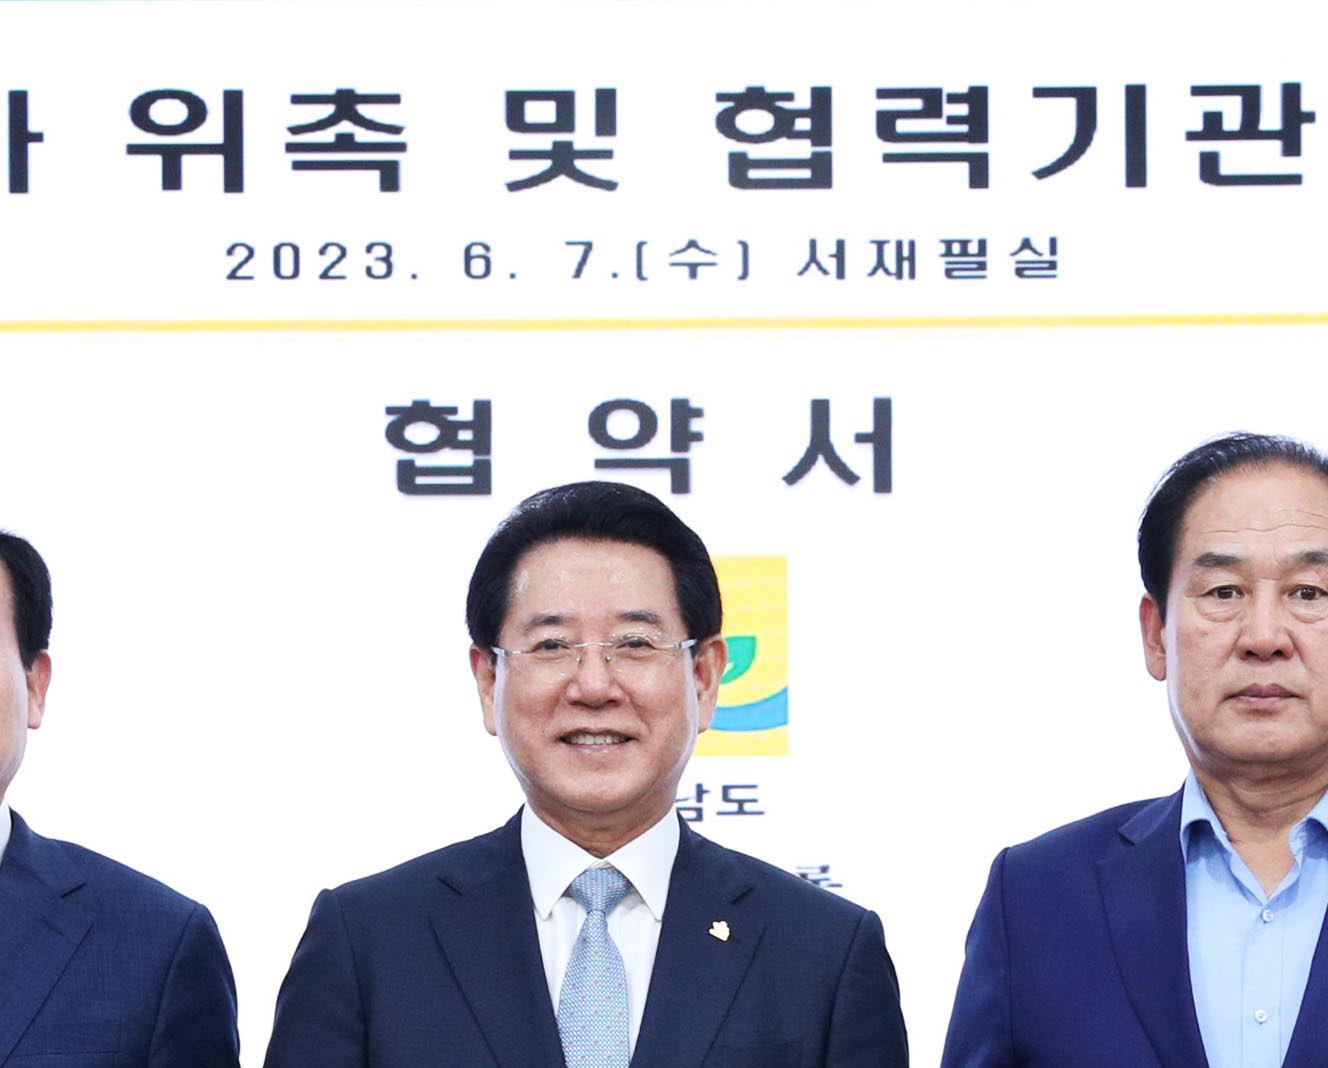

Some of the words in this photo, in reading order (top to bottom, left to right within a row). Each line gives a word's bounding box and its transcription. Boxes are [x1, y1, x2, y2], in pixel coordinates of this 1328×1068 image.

[126, 88, 408, 194] 위촉
[505, 86, 618, 192] 및
[715, 83, 1316, 191] 협력기관
[225, 241, 418, 281] 2023.
[463, 241, 517, 281] 6.
[797, 237, 1060, 281] 서재필실
[675, 783, 765, 823] 남도
